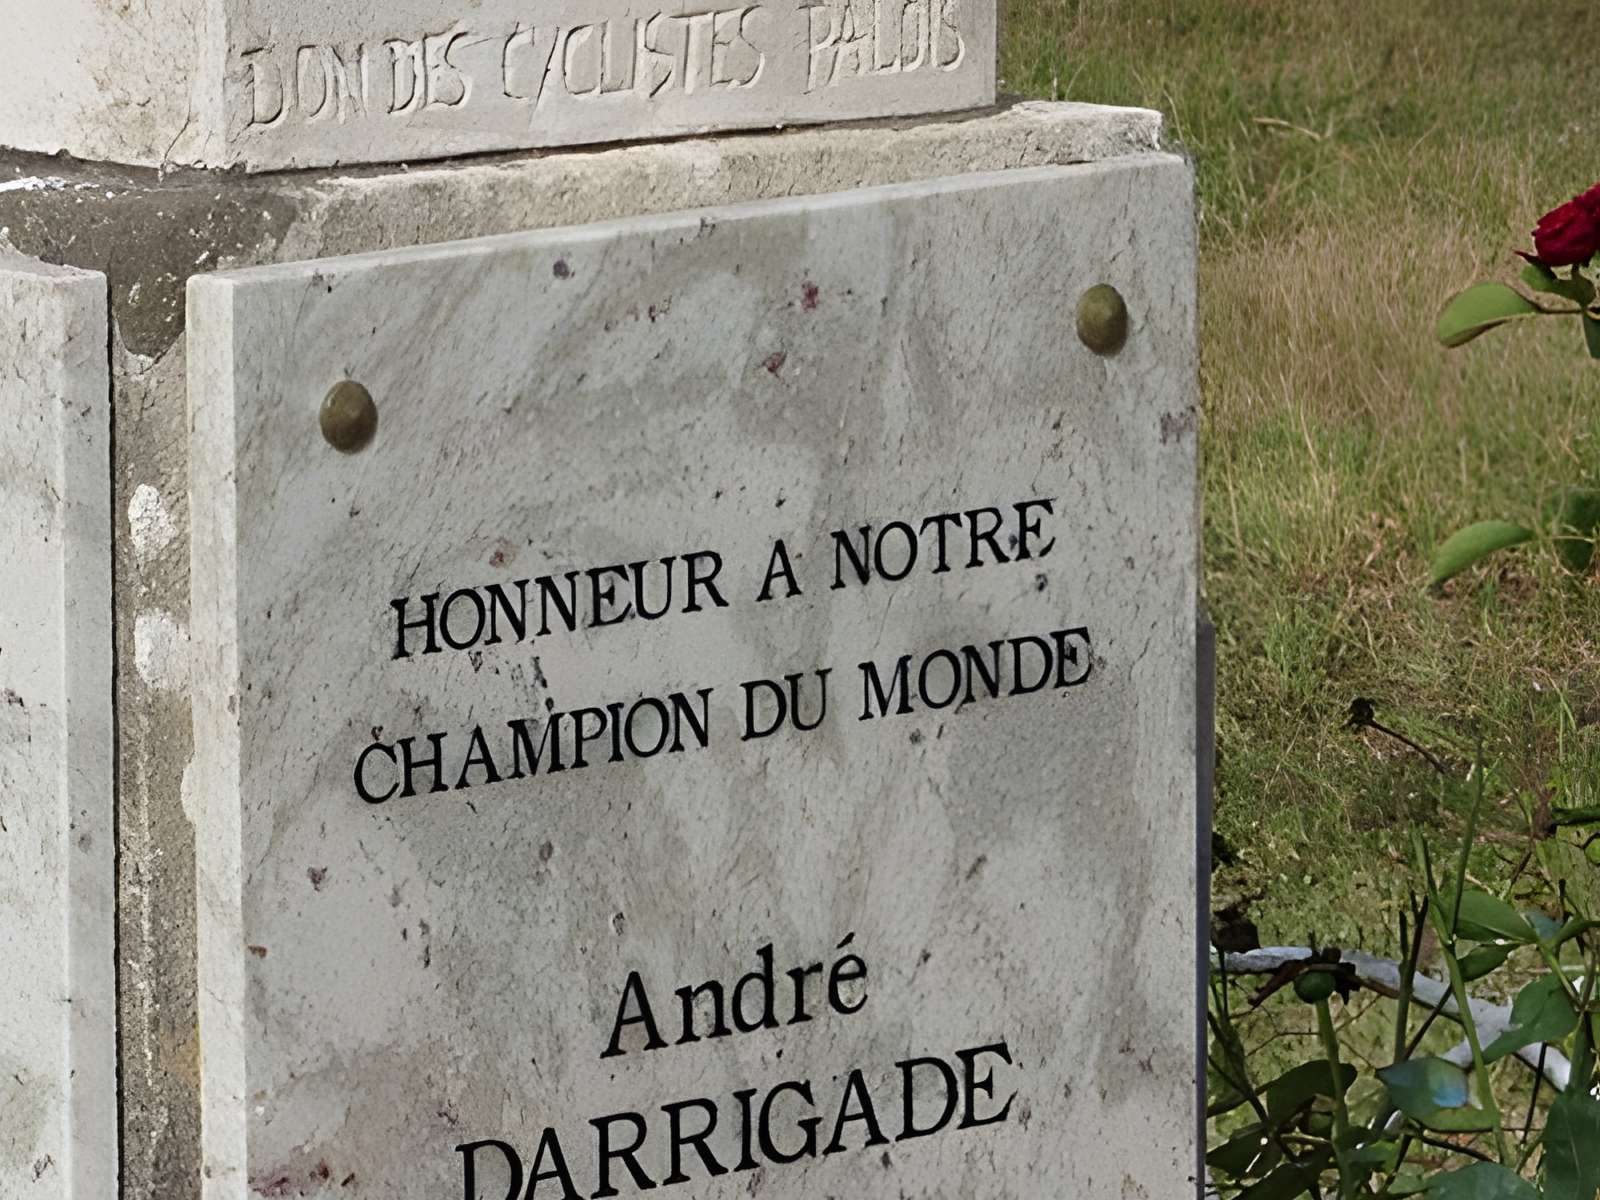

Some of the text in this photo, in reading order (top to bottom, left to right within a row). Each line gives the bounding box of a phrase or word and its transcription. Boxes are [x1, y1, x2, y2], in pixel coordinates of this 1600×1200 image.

[240, 40, 370, 127] DON
[382, 24, 473, 114] DES
[389, 498, 1056, 660] HONNEUR A NOTRE
[353, 627, 1094, 804] CHAMPION DU MONDE
[600, 932, 869, 1059] André
